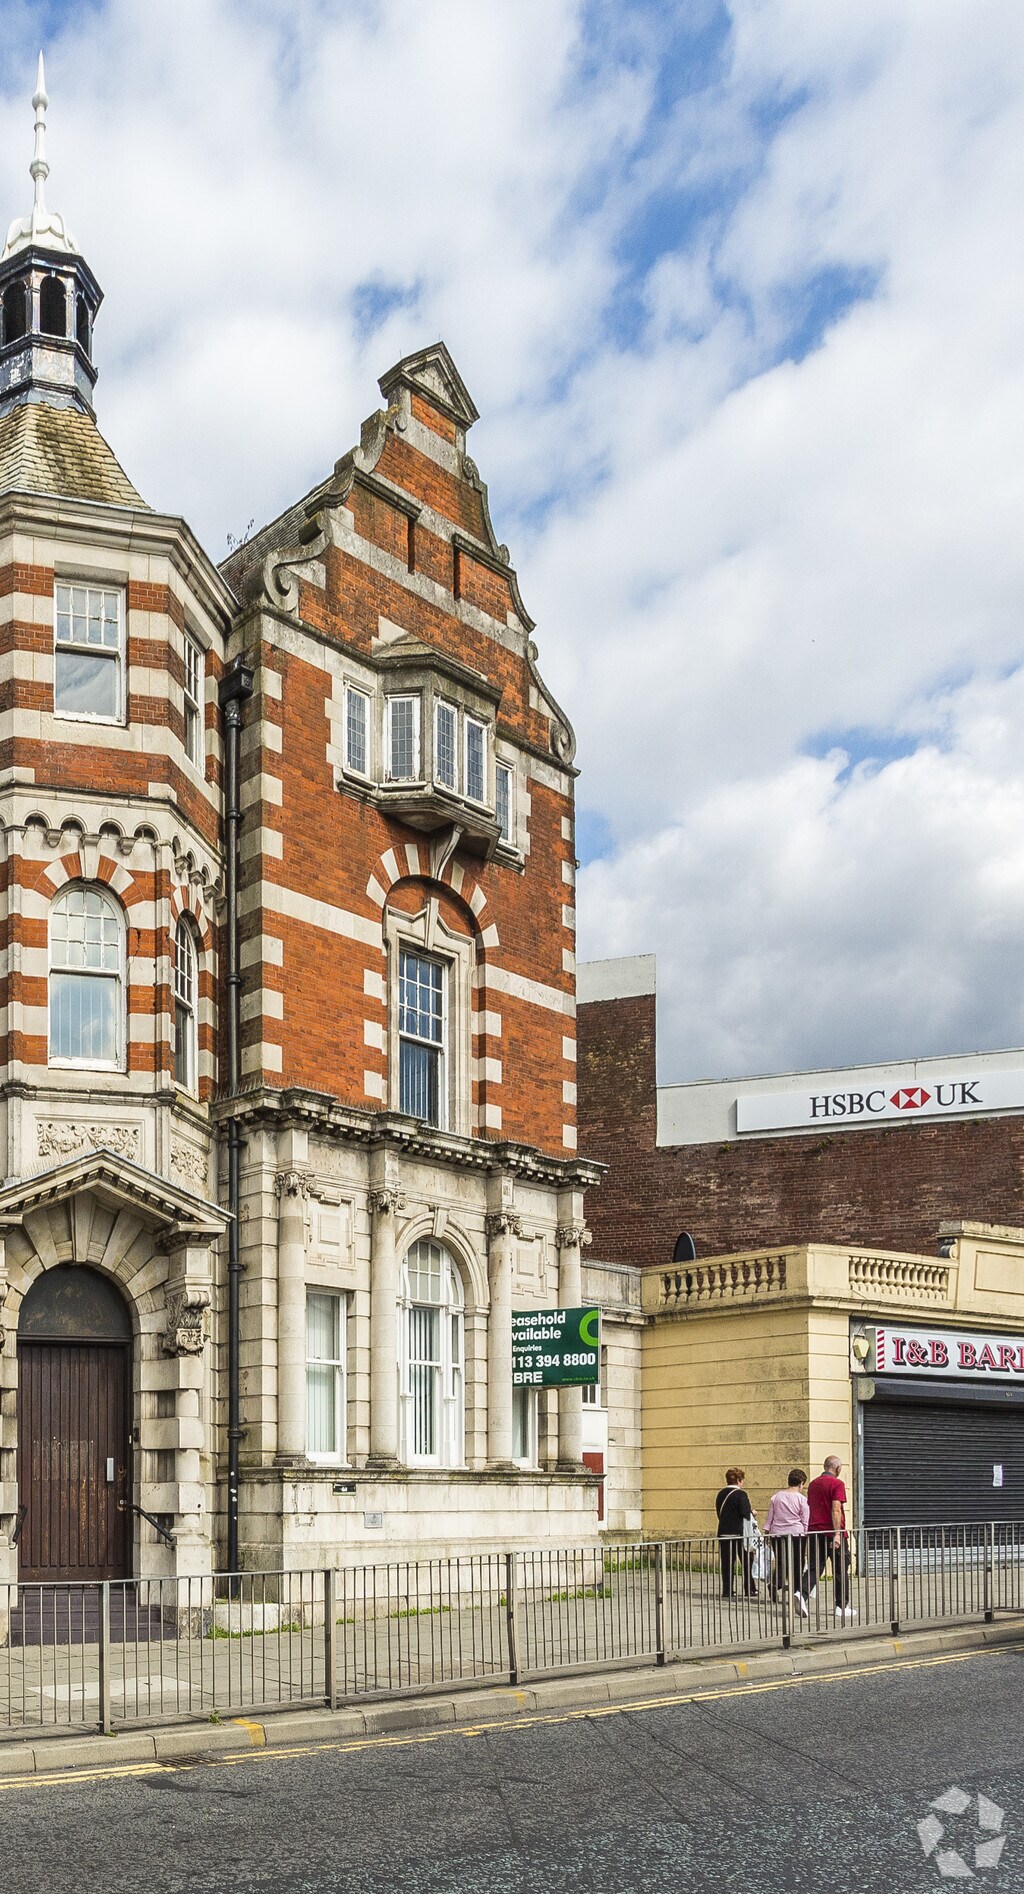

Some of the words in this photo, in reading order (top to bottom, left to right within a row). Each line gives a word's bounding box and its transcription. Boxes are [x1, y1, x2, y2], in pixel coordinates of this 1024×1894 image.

[809, 1090, 886, 1118] HSBC
[934, 1081, 983, 1107] UK
[512, 1326, 562, 1341] vailable
[512, 1344, 542, 1353] Enquiries
[891, 1337, 949, 1368] I&B
[536, 1354, 560, 1367] 394
[563, 1352, 596, 1367] 8800
[512, 1371, 543, 1384] BRE
